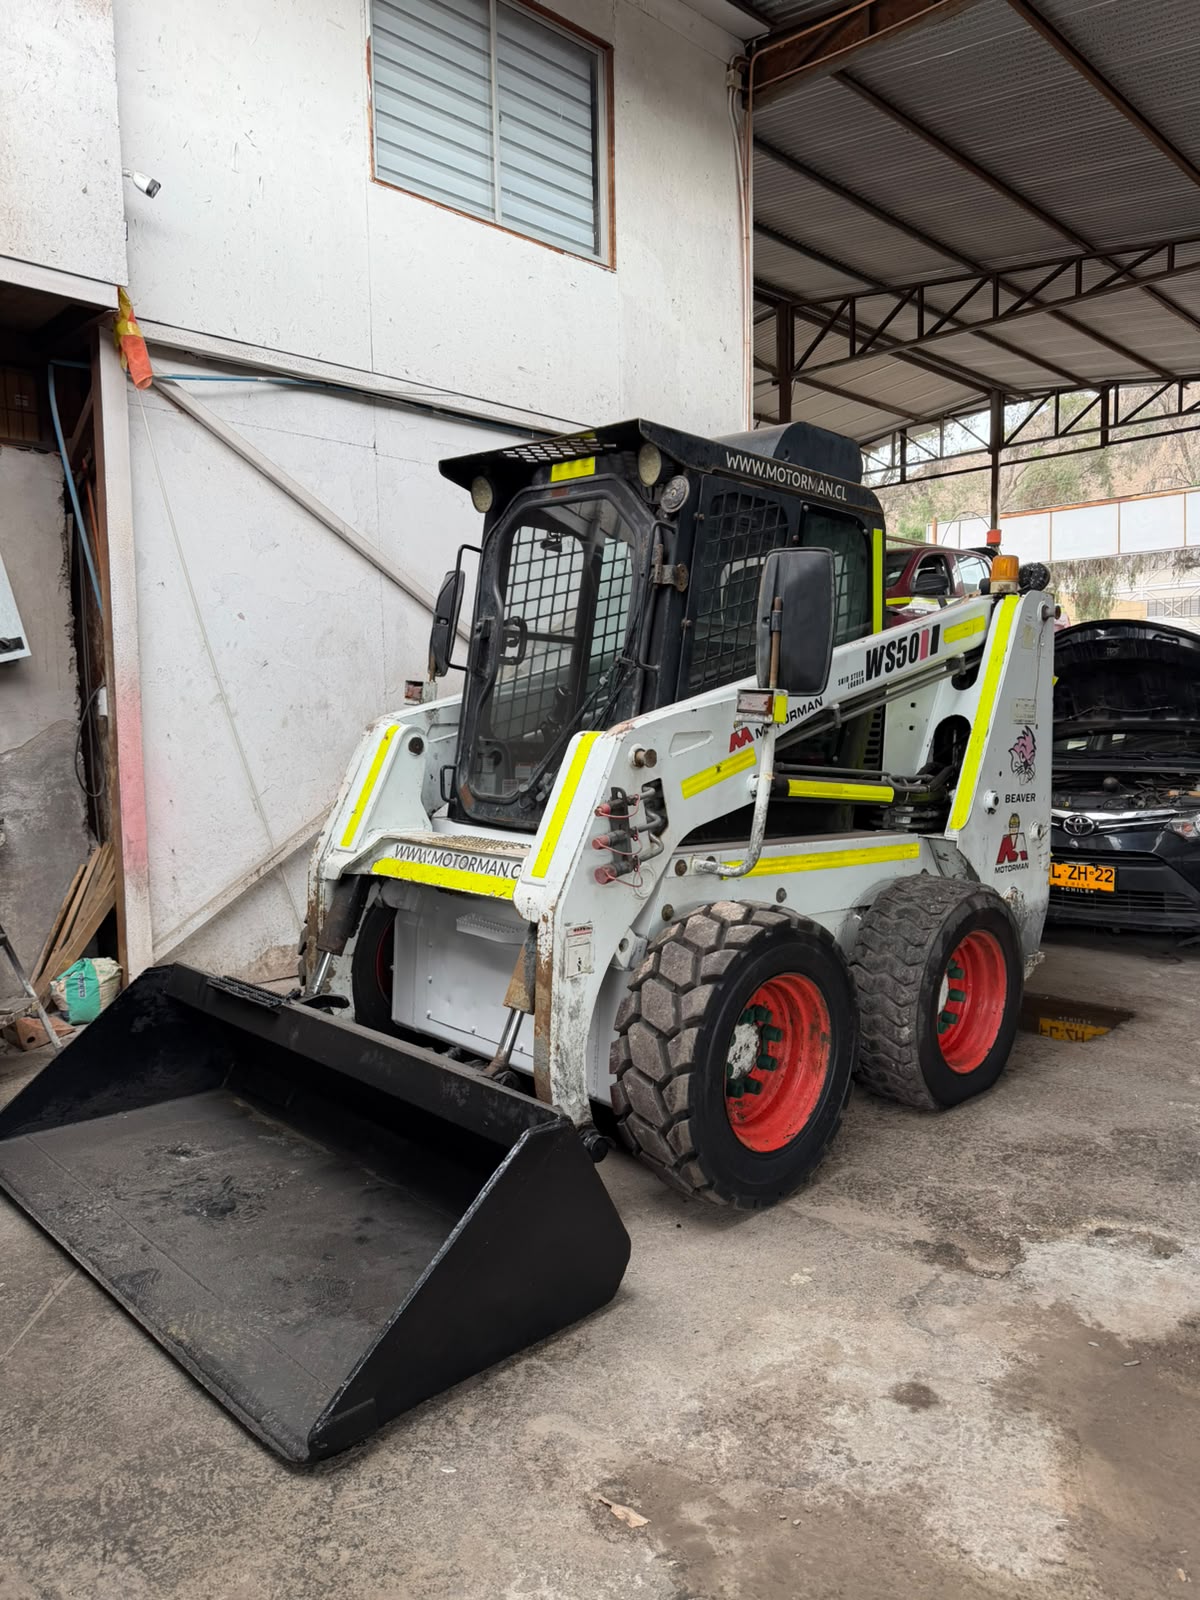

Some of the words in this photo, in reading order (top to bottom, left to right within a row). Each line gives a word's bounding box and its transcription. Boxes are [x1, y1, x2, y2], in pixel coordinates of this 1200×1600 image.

[726, 451, 847, 501] WWW.MOTORMAN.CL
[1004, 793, 1036, 804] BEAVER
[994, 862, 1029, 874] MOTORMAN
